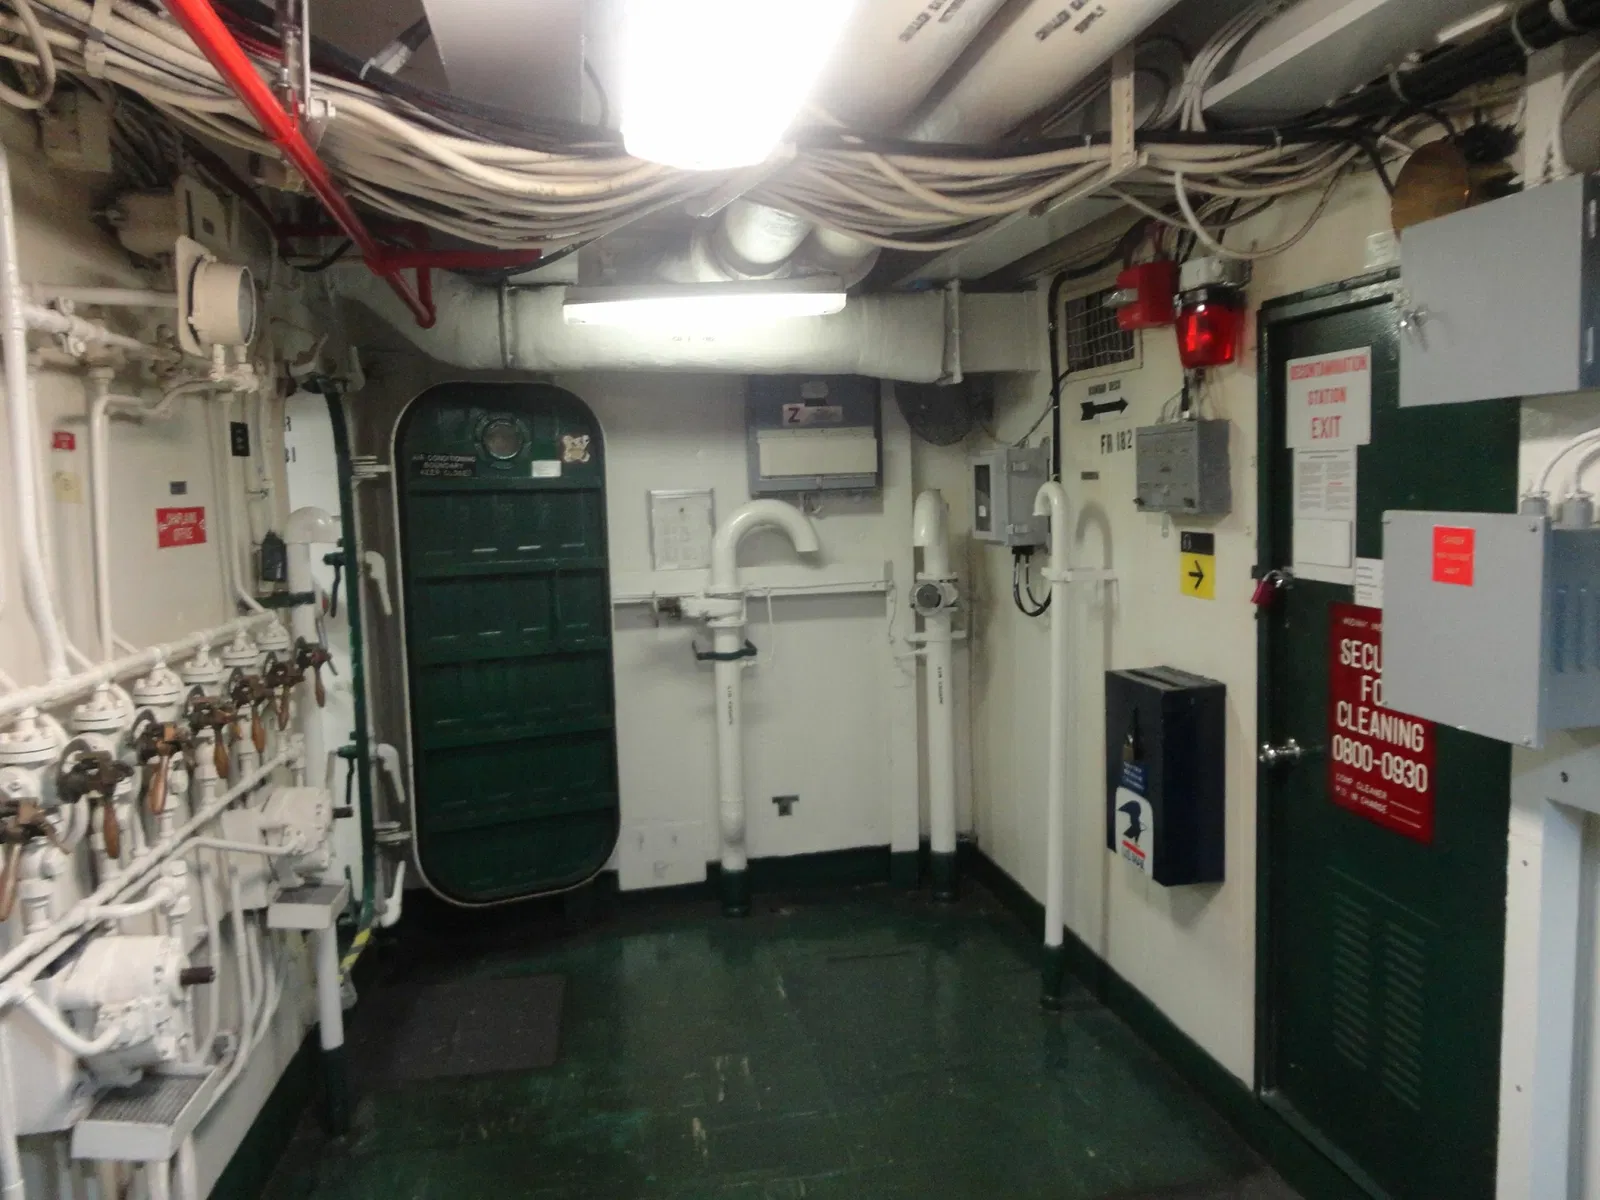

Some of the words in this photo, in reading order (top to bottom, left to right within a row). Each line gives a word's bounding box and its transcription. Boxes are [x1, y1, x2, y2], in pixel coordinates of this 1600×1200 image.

[1308, 387, 1347, 405] STATION
[788, 407, 801, 423] Z
[1311, 415, 1342, 439] EXIT
[1101, 433, 1113, 455] FR
[1117, 430, 1133, 452] 182
[1340, 638, 1382, 674] SECU
[1361, 675, 1383, 706] FO
[1336, 701, 1424, 752] CLEANING
[1332, 734, 1428, 793] 0800-0930
